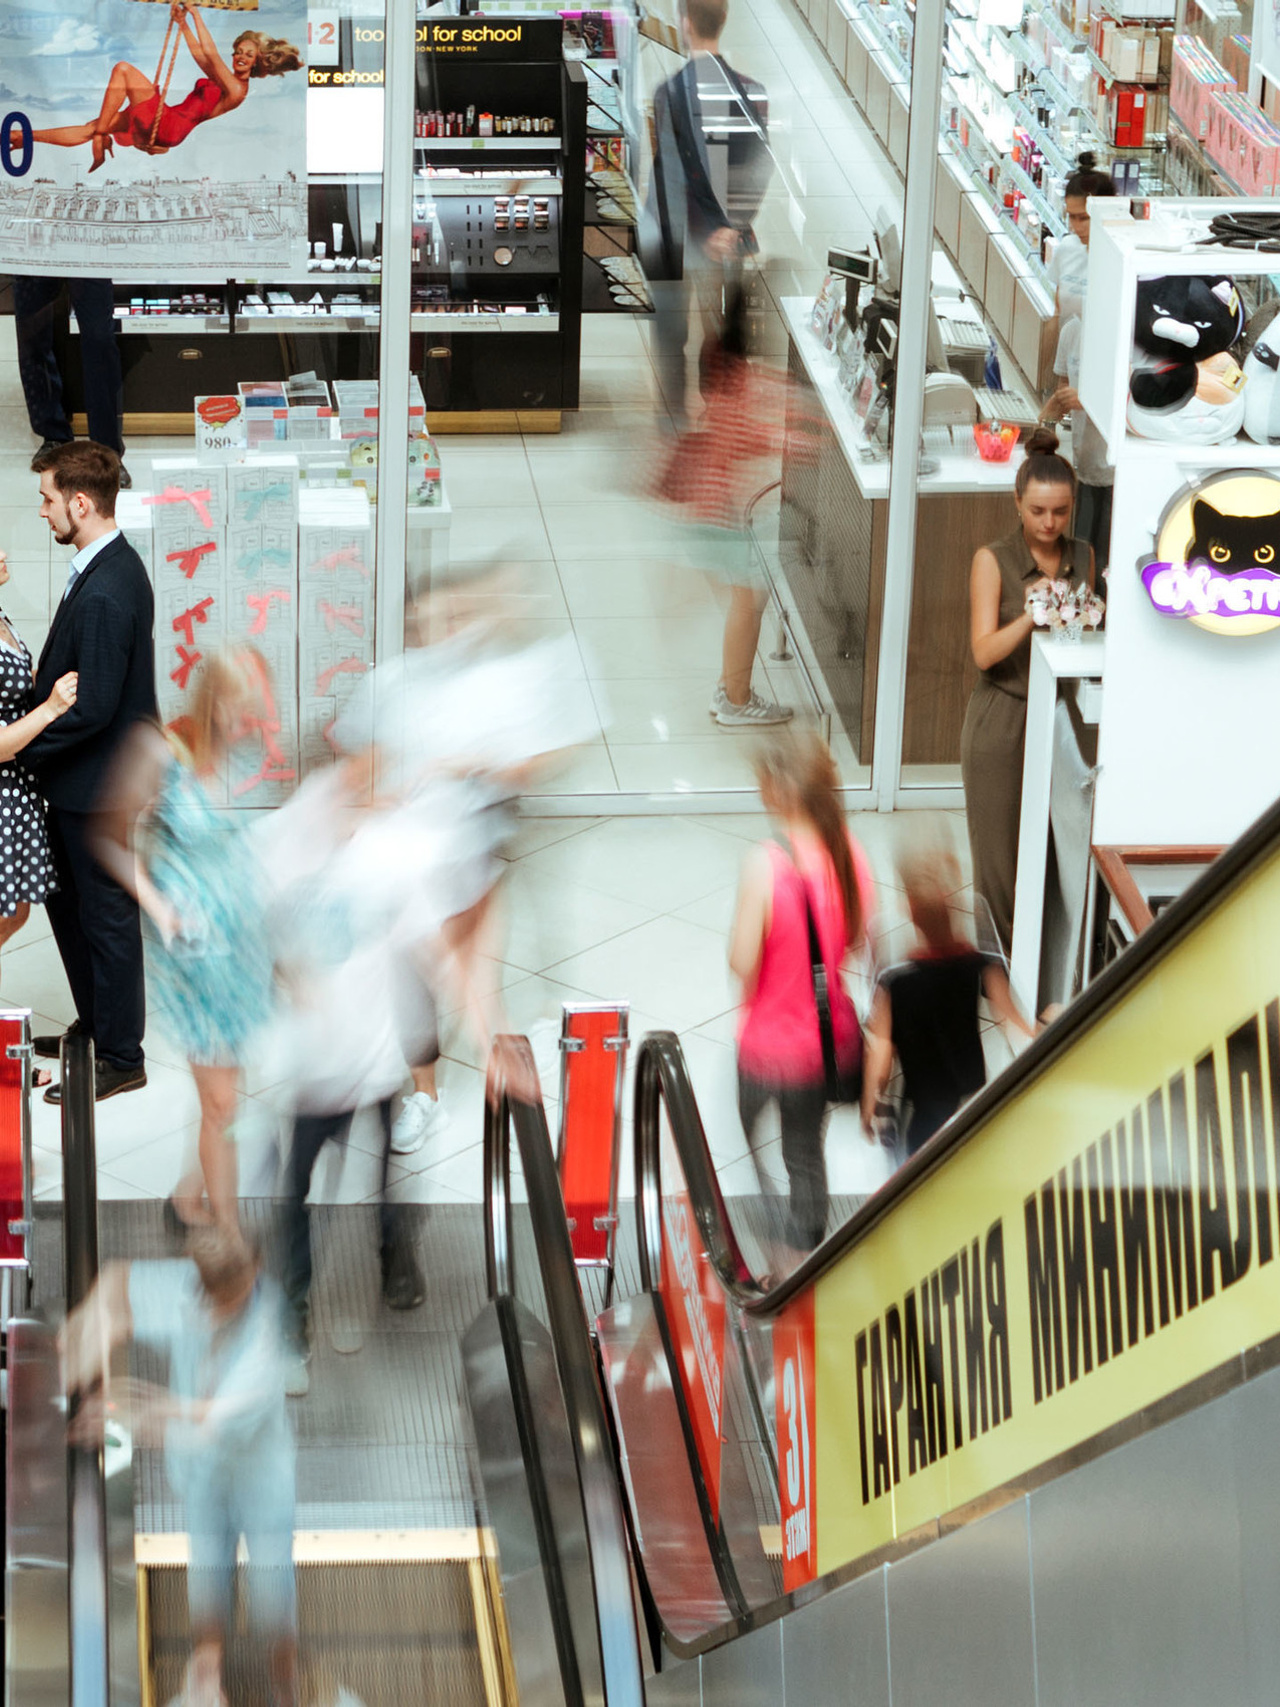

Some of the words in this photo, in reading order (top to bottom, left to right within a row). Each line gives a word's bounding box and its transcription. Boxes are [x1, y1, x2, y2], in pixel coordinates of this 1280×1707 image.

[355, 27, 384, 42] too
[433, 26, 458, 42] for
[461, 26, 521, 42] school
[309, 69, 330, 83] for
[333, 69, 384, 83] school
[855, 1217, 1013, 1505] ГАРАНТИЯ
